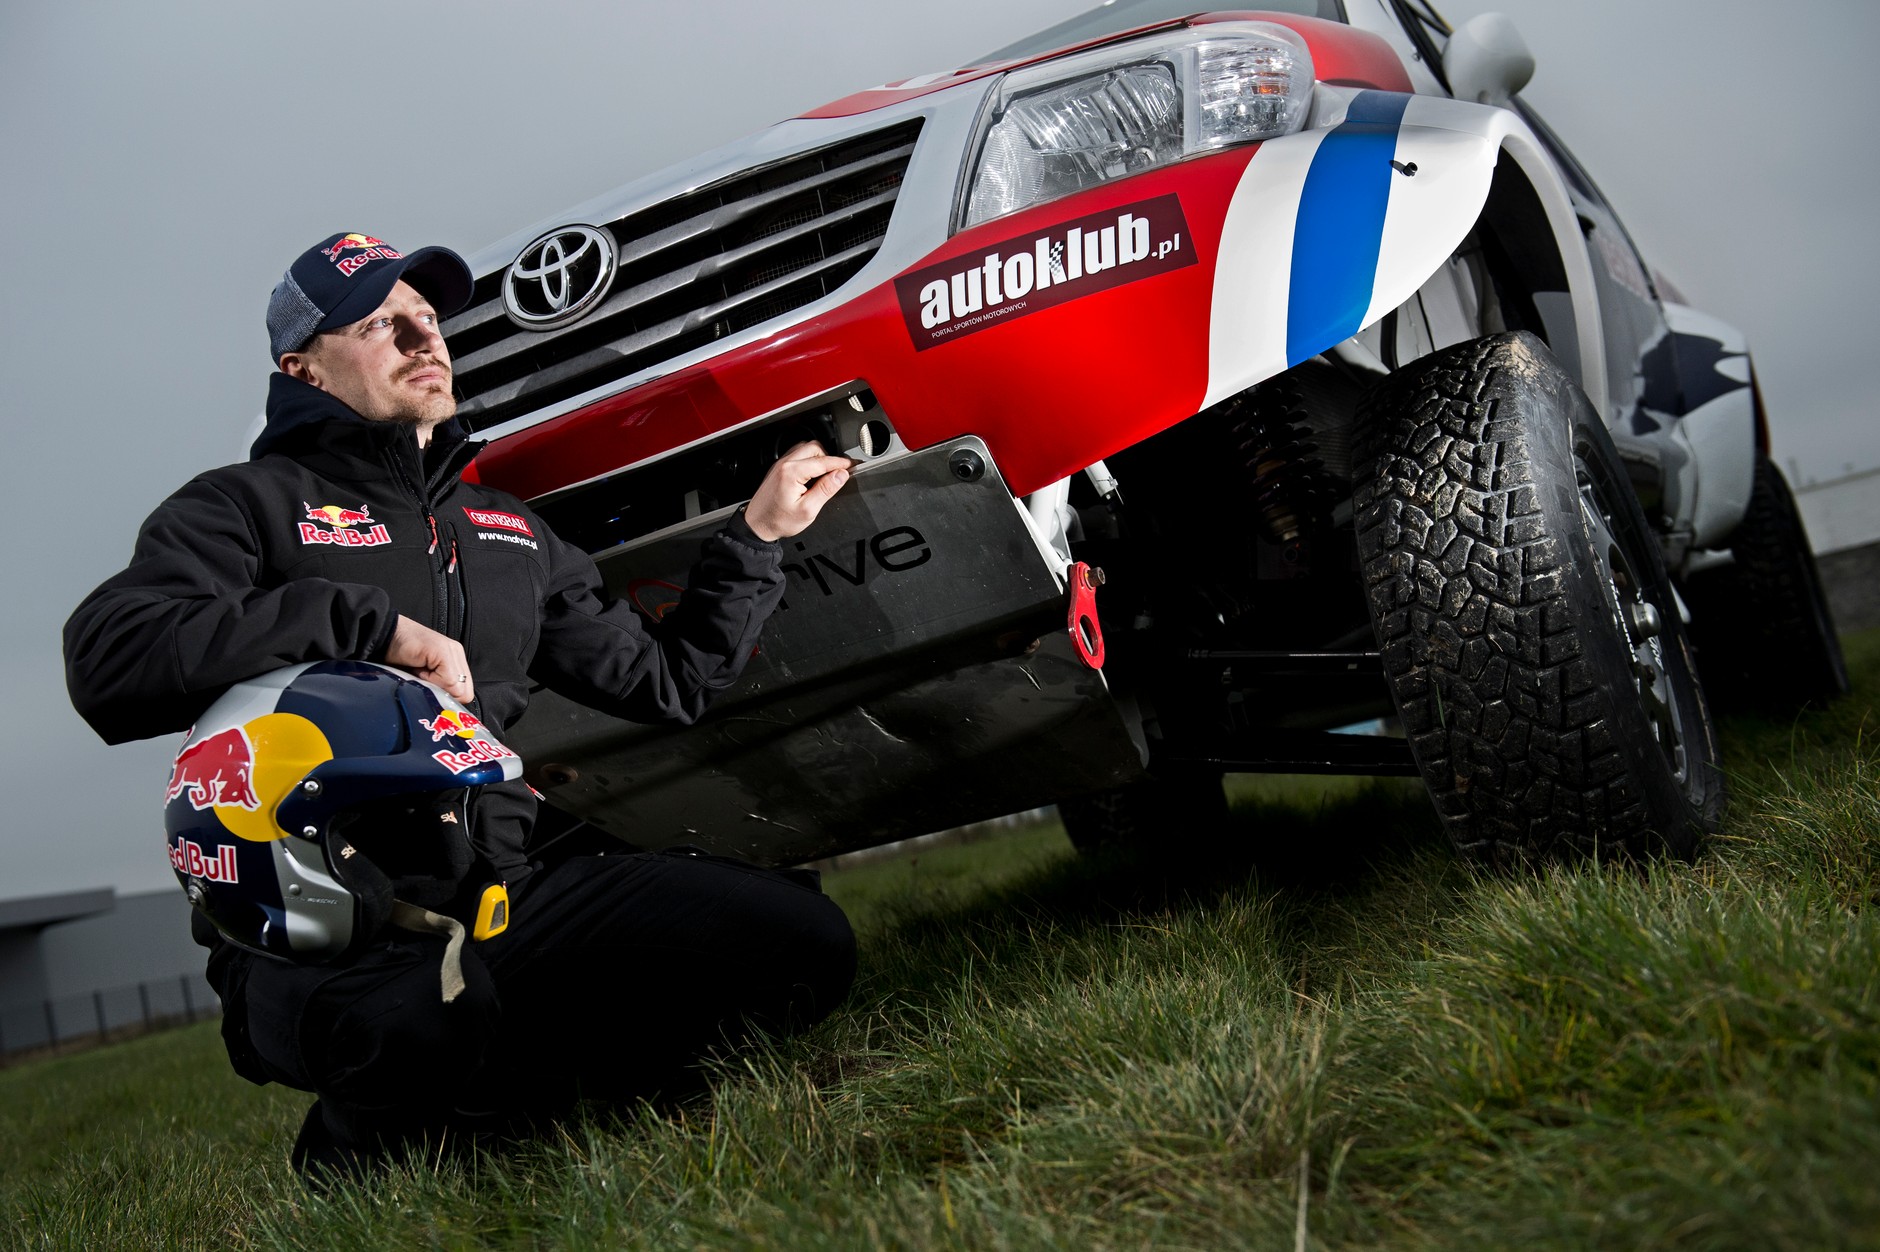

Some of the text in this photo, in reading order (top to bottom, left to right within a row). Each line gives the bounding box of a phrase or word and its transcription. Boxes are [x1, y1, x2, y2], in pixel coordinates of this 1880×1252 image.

[336, 248, 383, 277] Red
[919, 213, 1180, 330] autoklub.pl
[931, 301, 1027, 339] PORTAL SPORTÓW MOTOROWYCH
[298, 522, 392, 546] Red Bull
[774, 525, 932, 613] rive
[432, 739, 493, 775] Red
[164, 836, 239, 884] ed Bull
